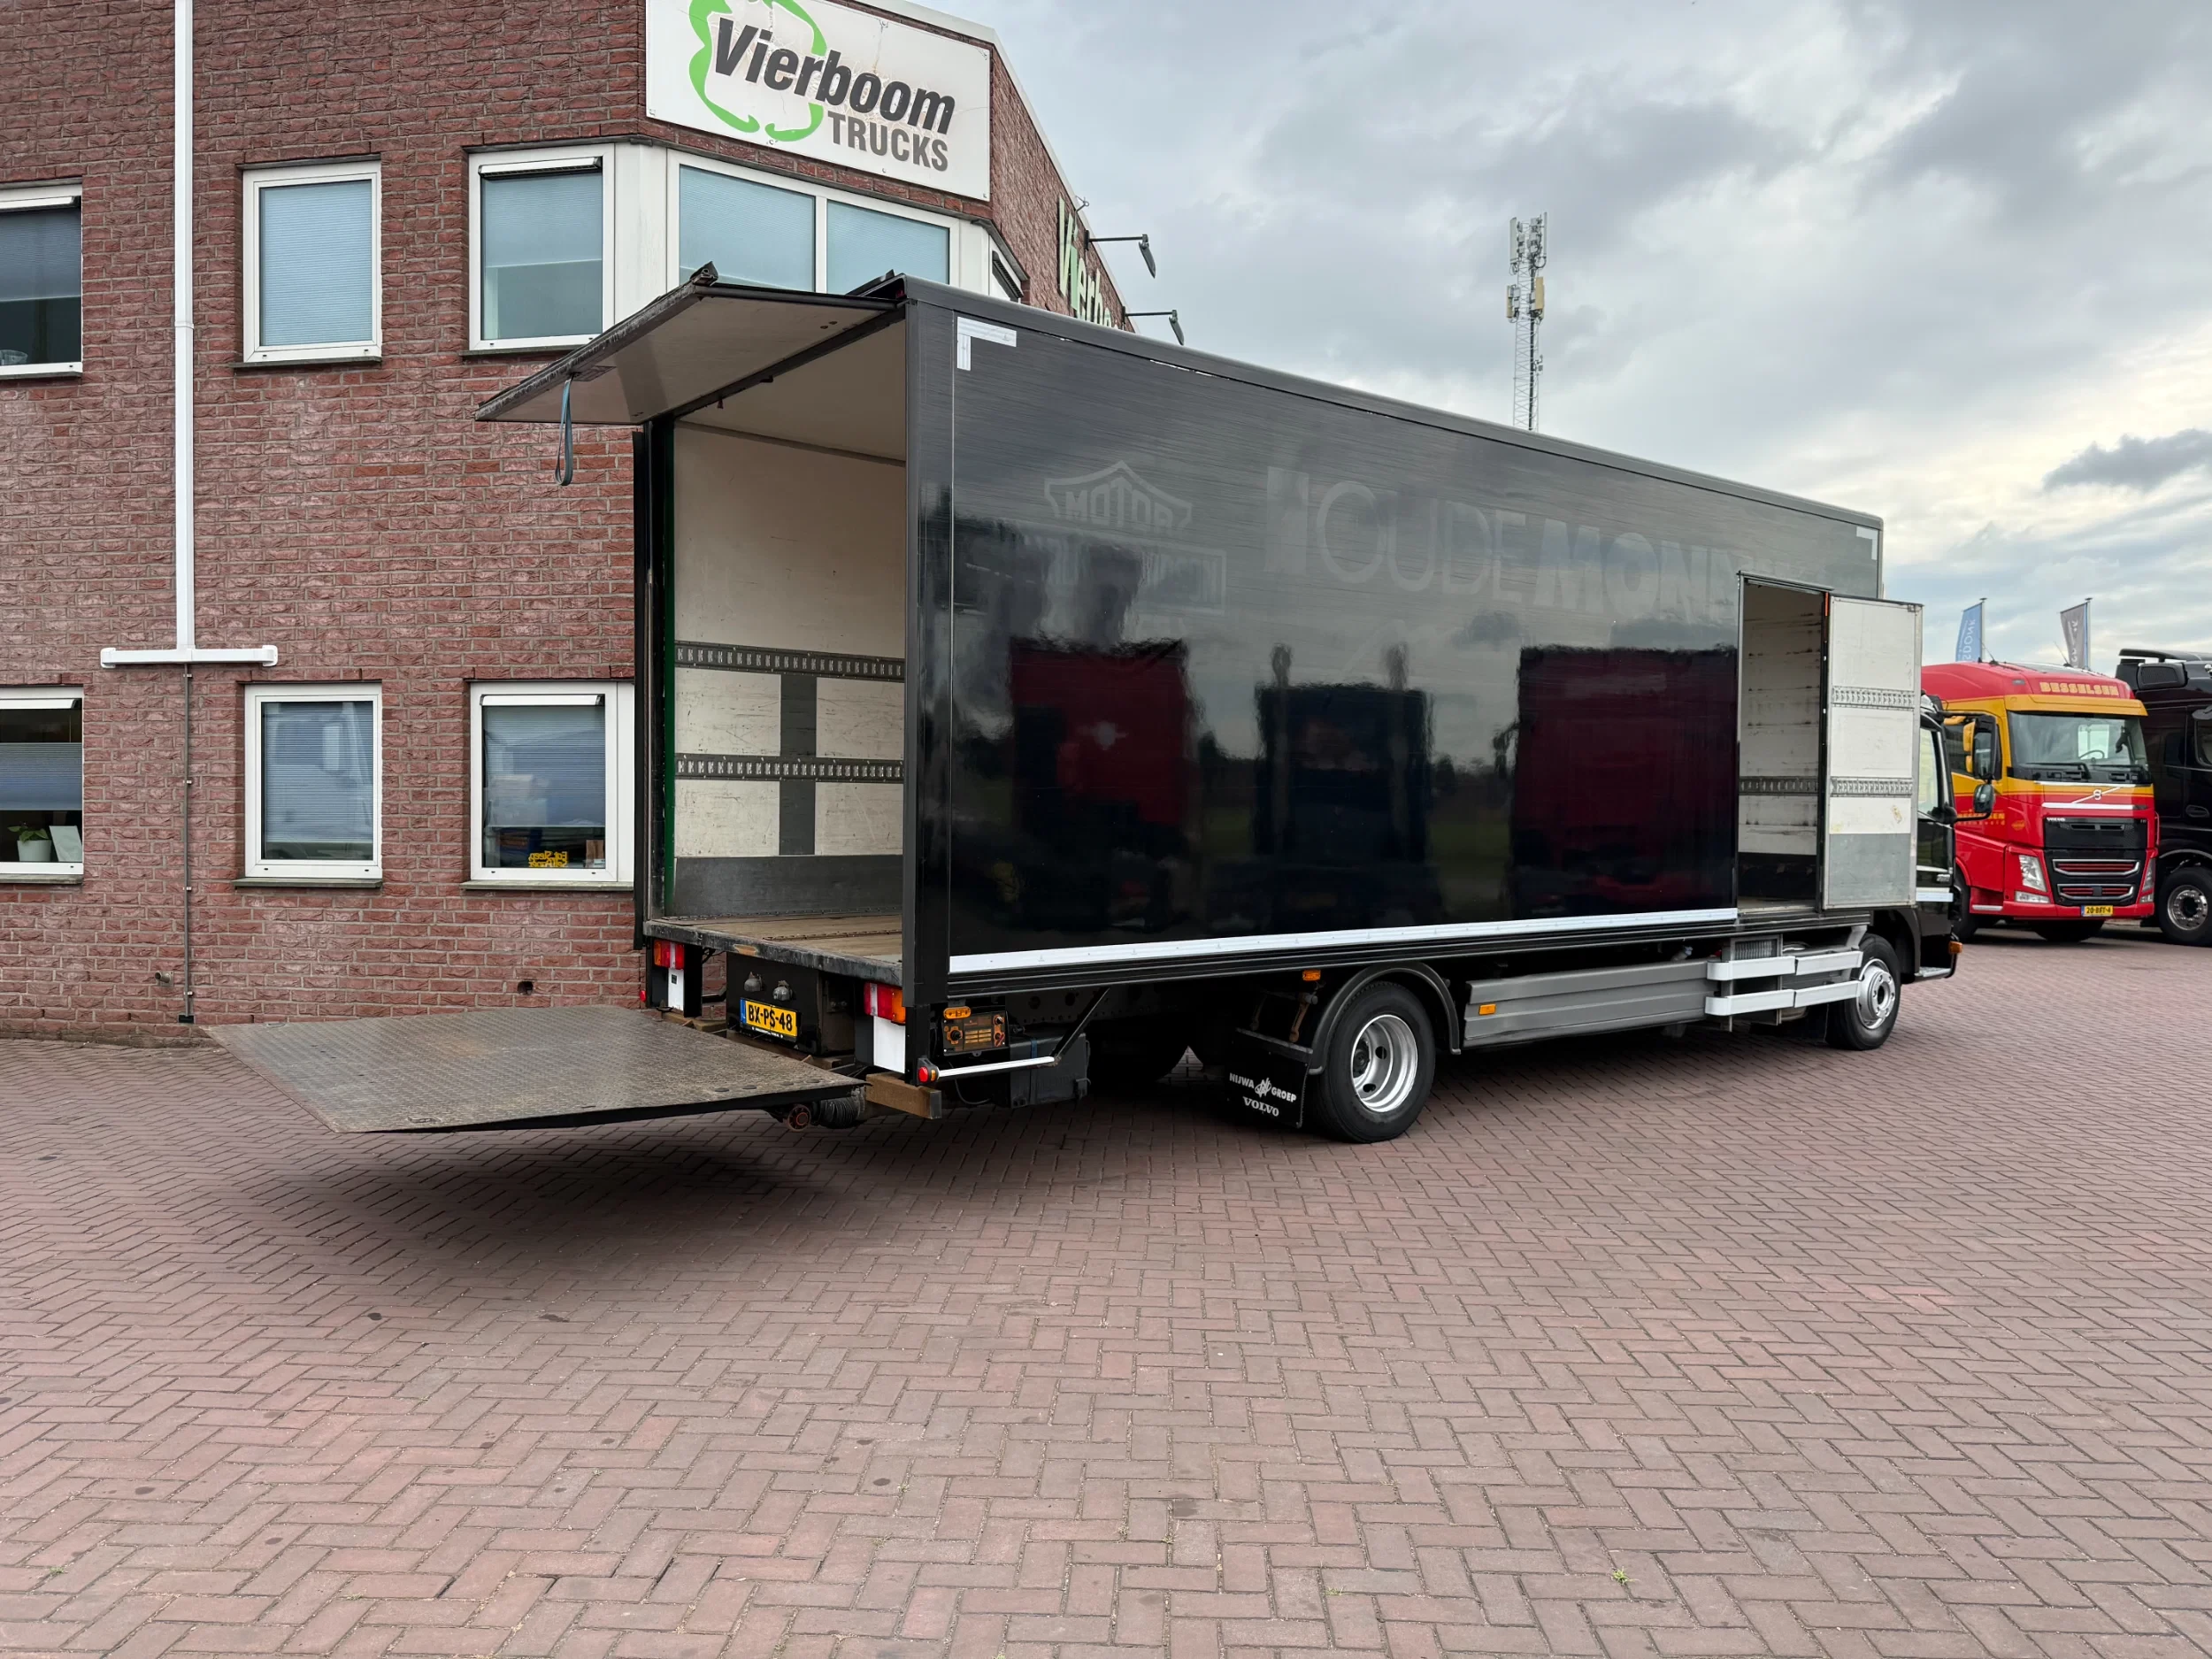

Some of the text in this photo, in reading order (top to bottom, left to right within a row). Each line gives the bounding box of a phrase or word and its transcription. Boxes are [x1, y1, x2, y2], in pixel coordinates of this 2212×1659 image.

[713, 18, 956, 135] Vierboom
[827, 110, 949, 173] TRUCKS
[1064, 475, 1174, 534] MOTOR
[748, 1004, 793, 1032] BX-PS-48
[1229, 1072, 1297, 1102] NIJWA GROEP
[1242, 1095, 1279, 1117] VOLVO
